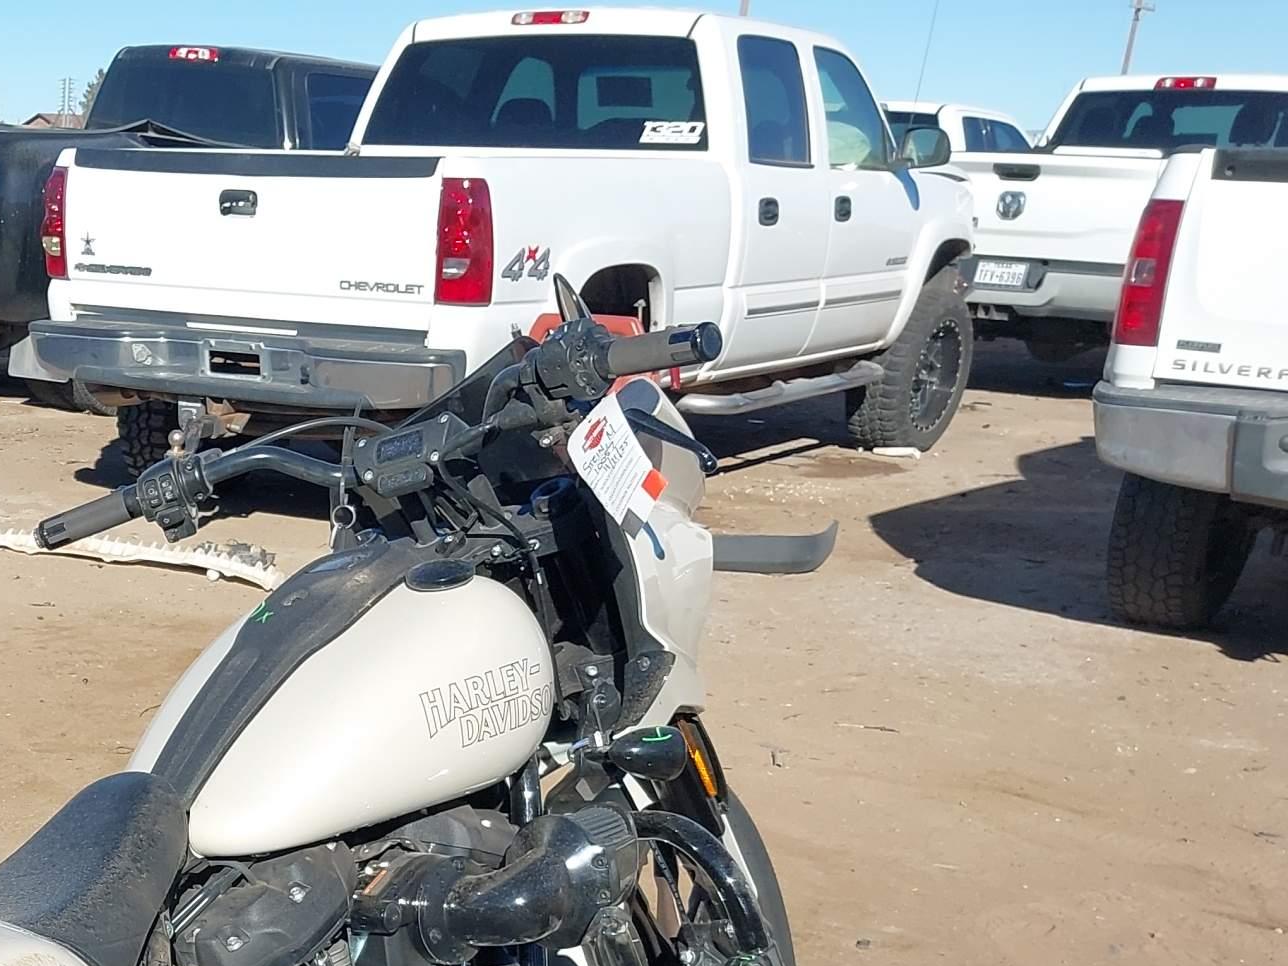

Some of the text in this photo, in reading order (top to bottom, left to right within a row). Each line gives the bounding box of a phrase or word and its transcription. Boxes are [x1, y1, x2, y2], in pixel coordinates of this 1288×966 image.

[644, 121, 705, 137] 1320
[339, 280, 425, 295] CHEVROLET
[418, 658, 541, 738] HARLEY-
[459, 684, 553, 748] DAVIDSO
